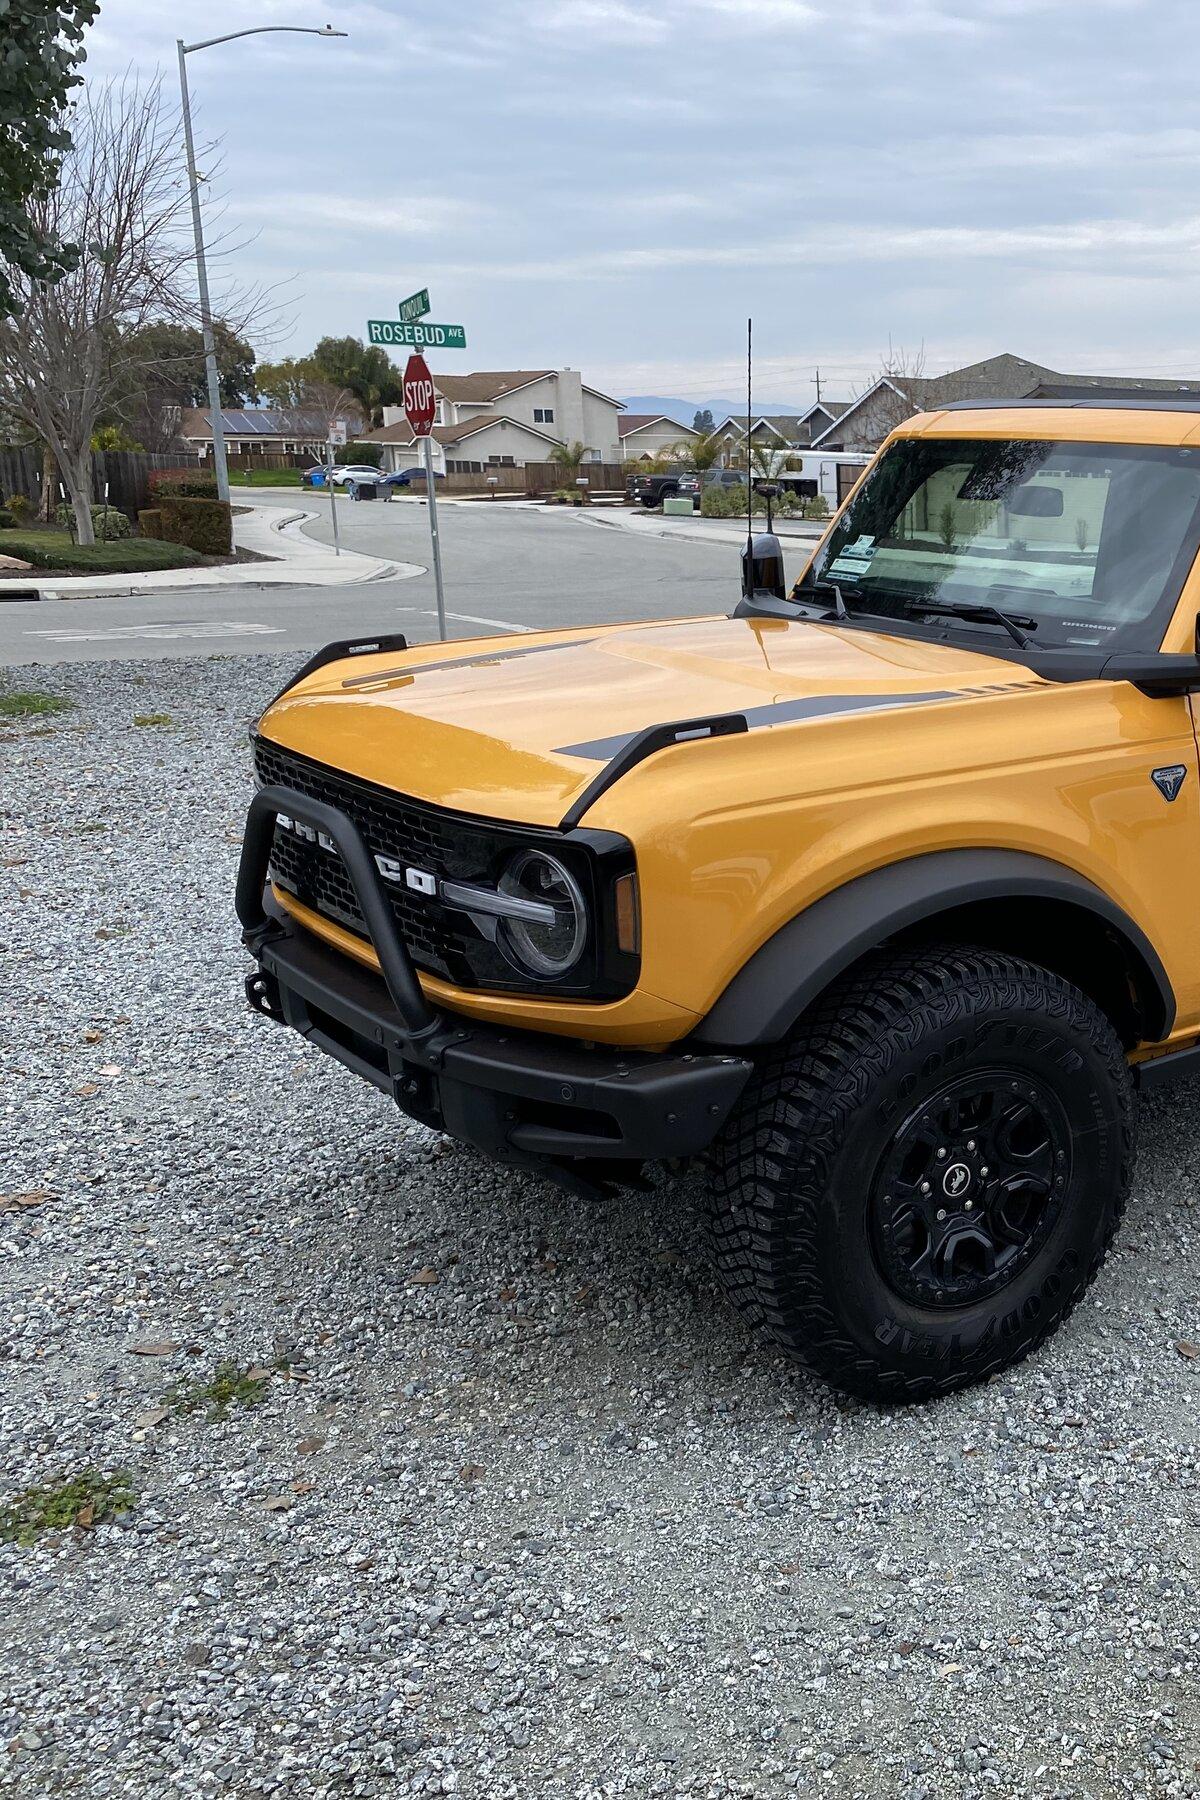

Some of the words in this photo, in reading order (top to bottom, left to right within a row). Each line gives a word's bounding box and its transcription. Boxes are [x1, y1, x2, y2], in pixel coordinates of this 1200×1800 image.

[370, 323, 446, 345] ROSEBUD
[448, 328, 464, 339] AVE
[405, 380, 432, 412] STOP
